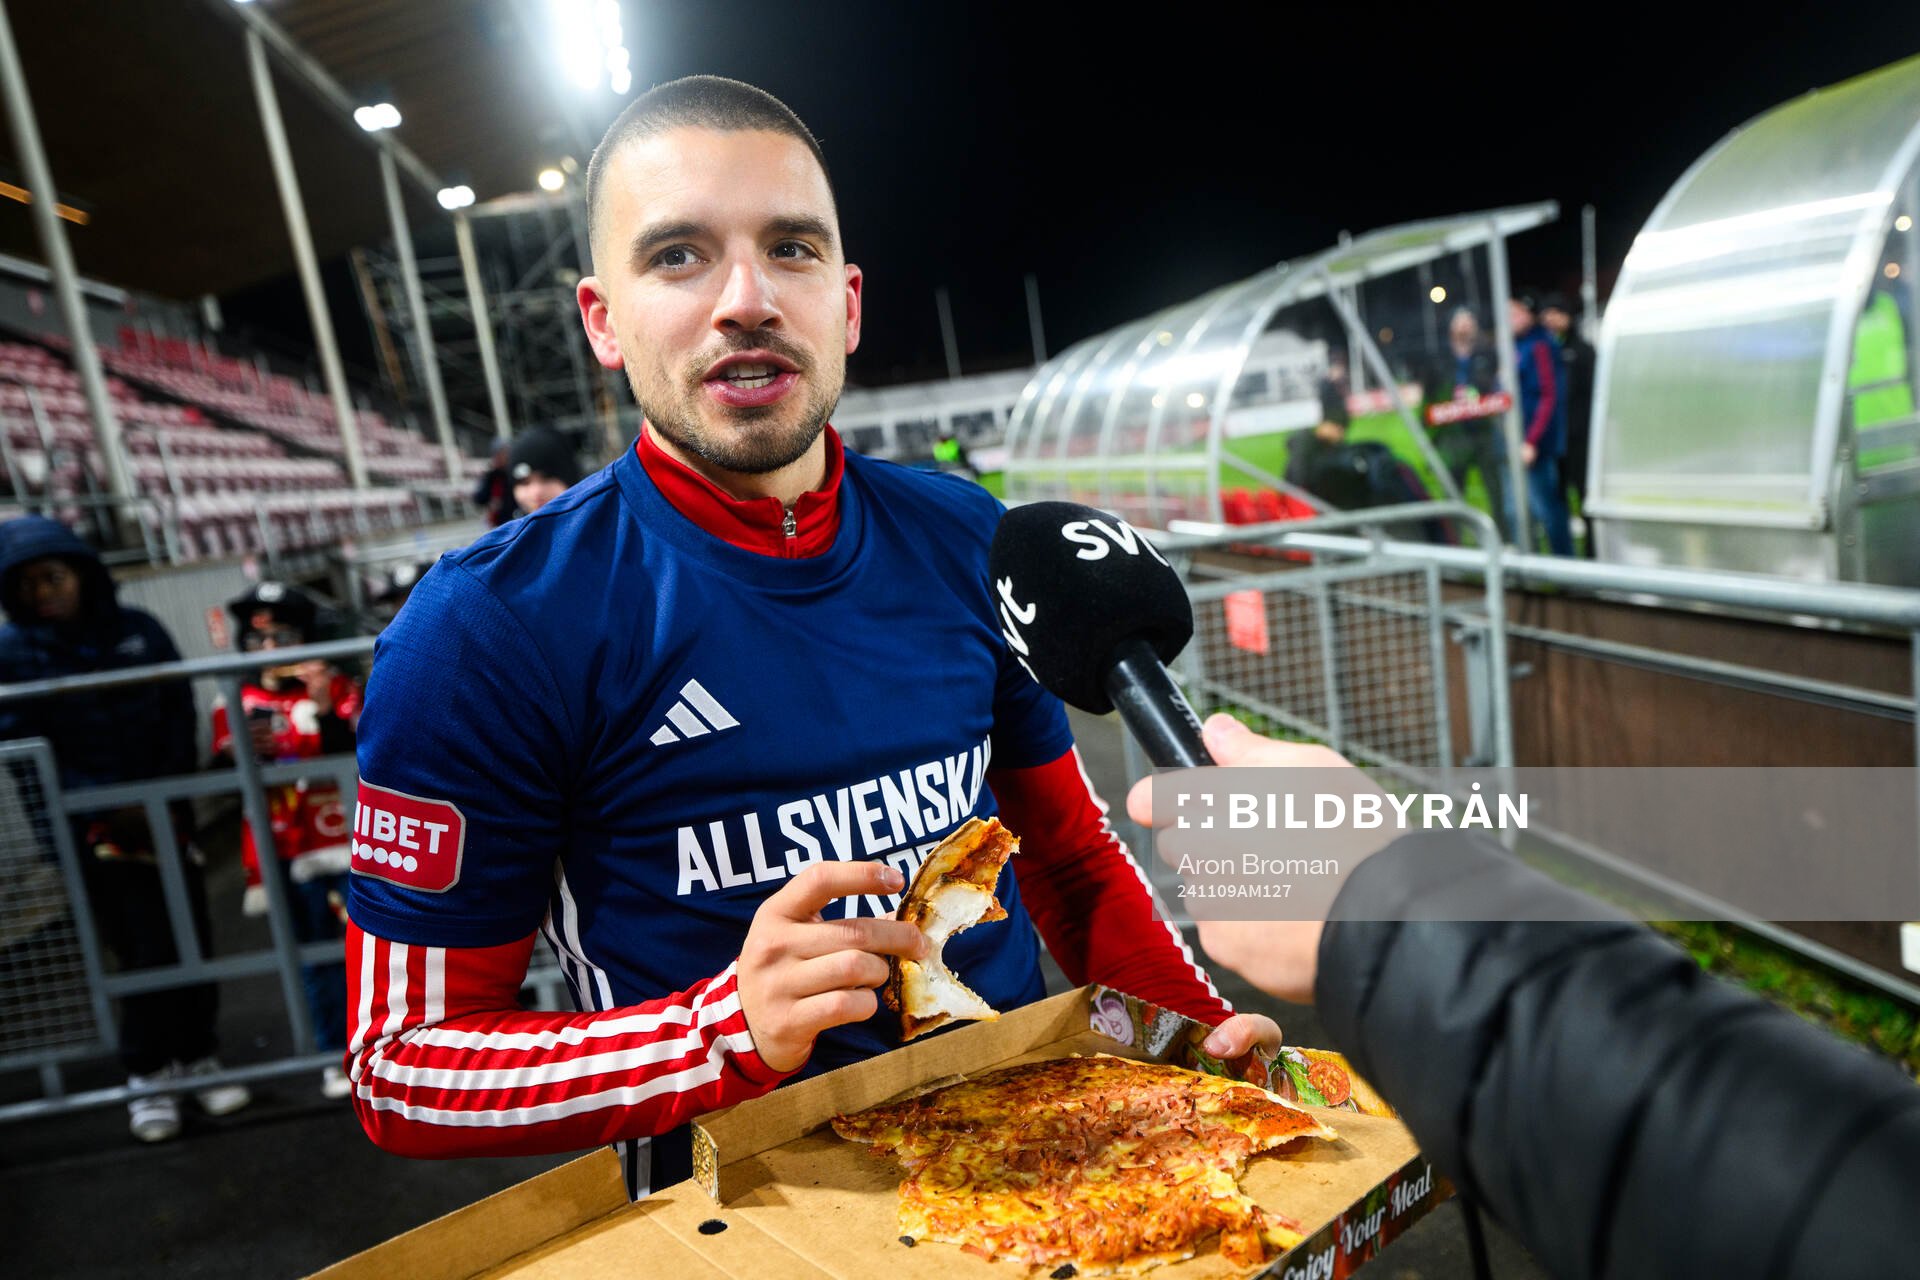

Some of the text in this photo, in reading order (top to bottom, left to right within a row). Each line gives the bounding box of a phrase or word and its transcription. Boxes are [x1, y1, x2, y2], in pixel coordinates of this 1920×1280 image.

[996, 576, 1040, 684] vt
[1340, 1206, 1386, 1255] Your
[1390, 1163, 1432, 1220] Meal
